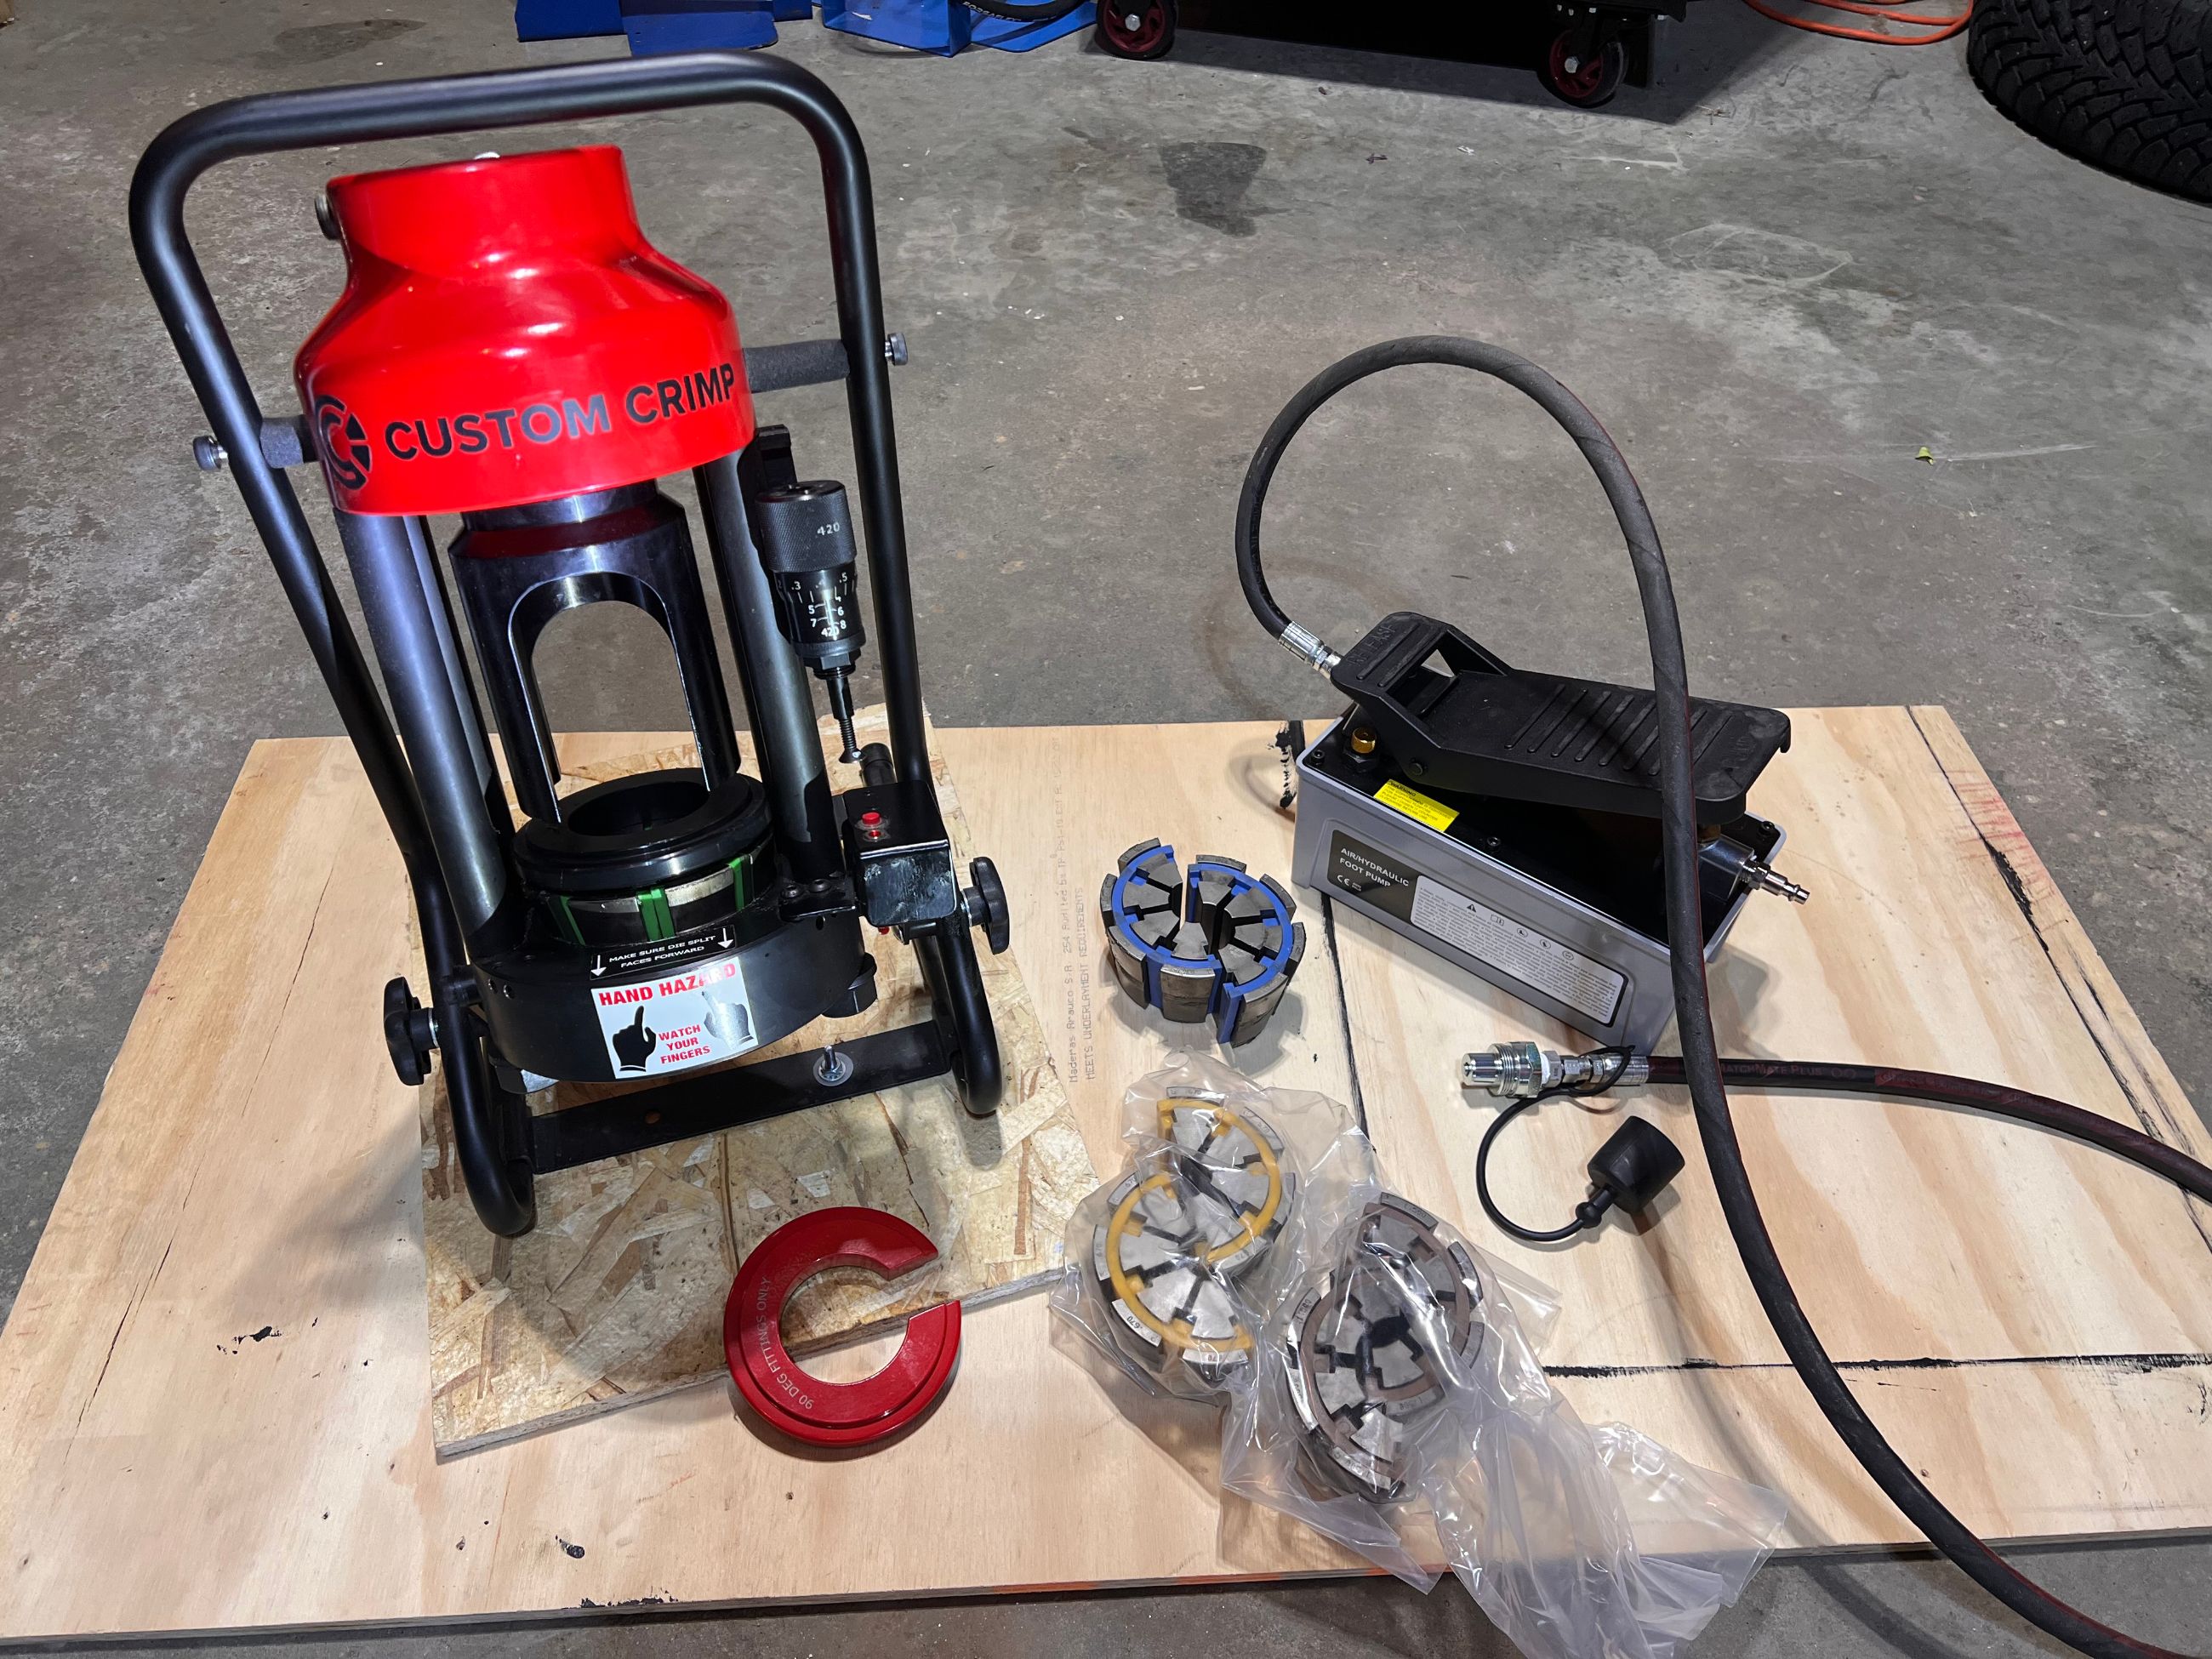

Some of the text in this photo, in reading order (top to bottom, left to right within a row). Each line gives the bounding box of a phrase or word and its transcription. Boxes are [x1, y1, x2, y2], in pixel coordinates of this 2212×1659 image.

[385, 362, 735, 461] CUSTOM CRIMP
[791, 581, 801, 590] .3
[839, 572, 848, 584] .5
[807, 605, 815, 614] 5
[837, 607, 845, 616] 6
[810, 619, 818, 628] 7
[839, 619, 847, 630] 8
[1340, 858, 1391, 887] FOOT PUMP
[1341, 848, 1410, 887] AIR/HYDRAULIC
[609, 936, 716, 963] MAKE SURE DIE SPLIT
[621, 946, 704, 968] FACES FORWARD
[599, 986, 653, 1006] HAND
[1080, 963, 1092, 1040] UNDERLAYMENT
[1067, 991, 1075, 1029] Arauco
[658, 1024, 701, 1041] WATCH
[660, 1046, 710, 1064] FINGERS
[666, 1037, 699, 1052] YOUR
[1069, 1036, 1078, 1082] Maderas
[1085, 1046, 1095, 1080] MEETS
[756, 1276, 814, 1409] 90 DEG FITTINGS ONLY
